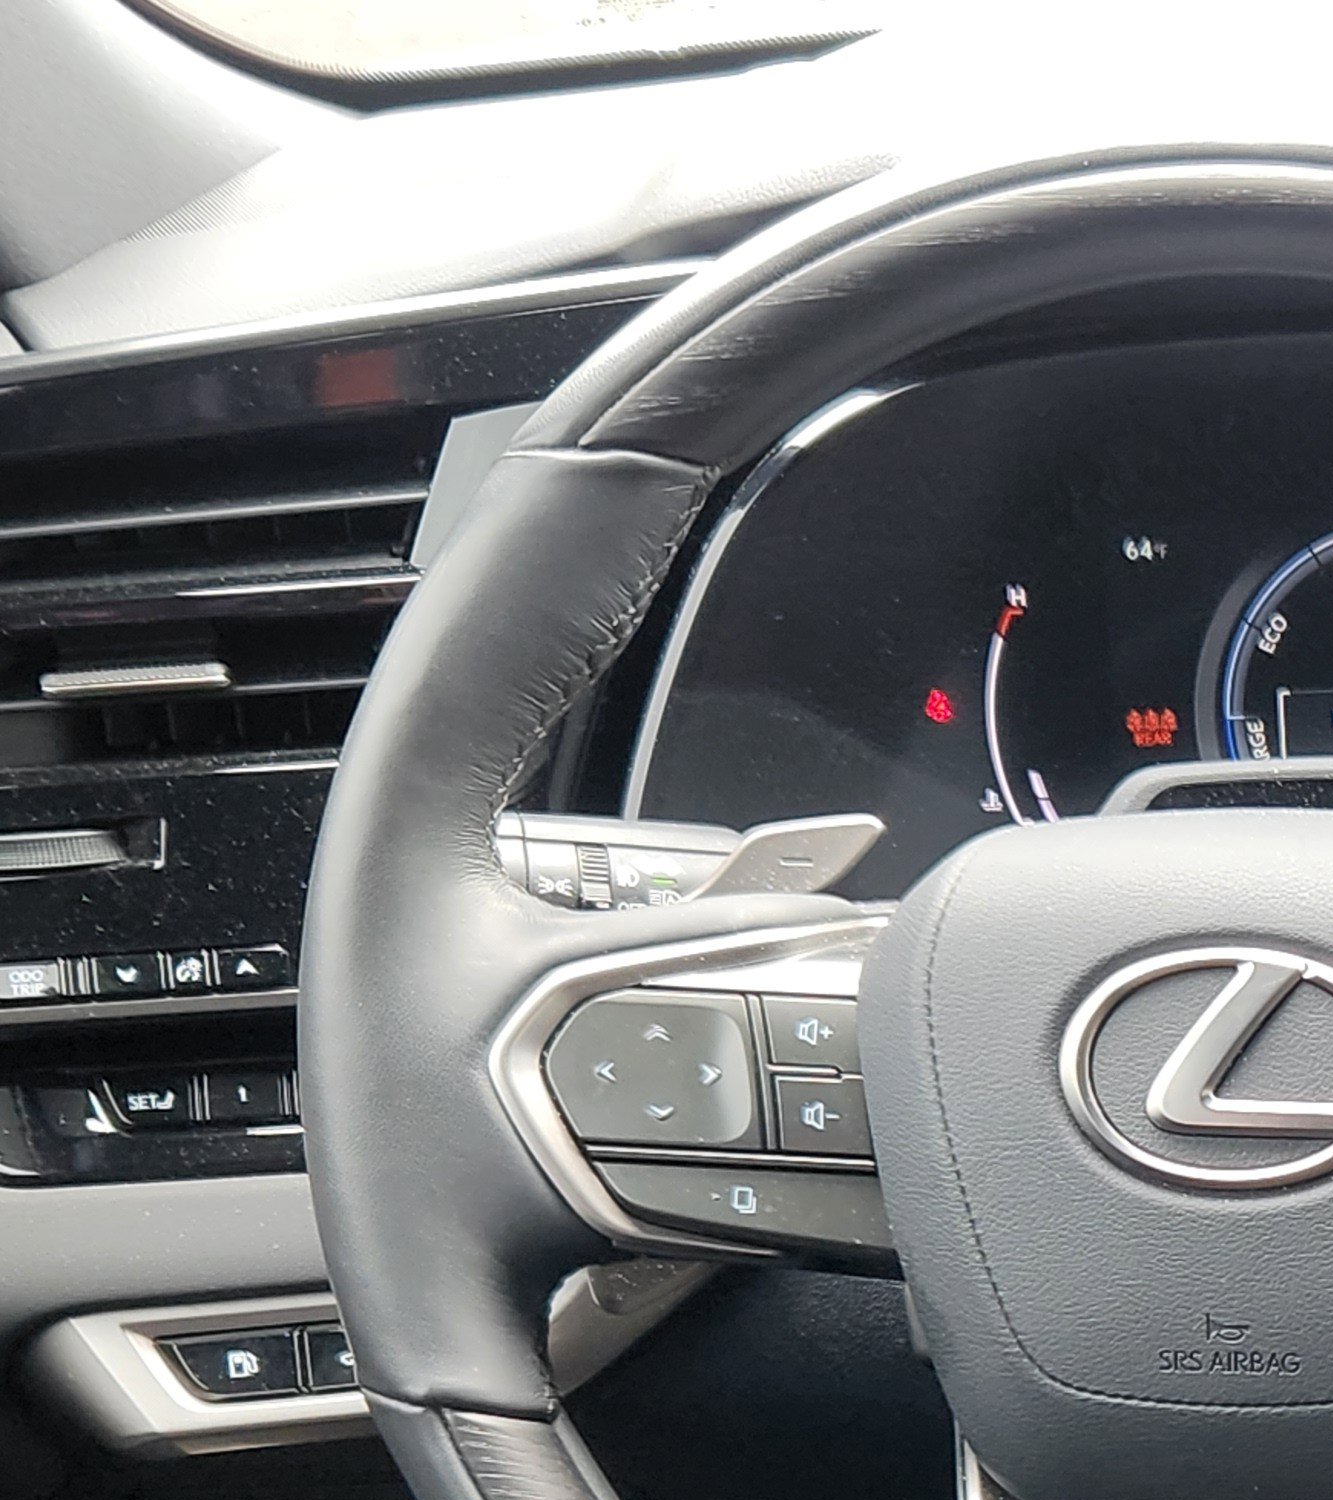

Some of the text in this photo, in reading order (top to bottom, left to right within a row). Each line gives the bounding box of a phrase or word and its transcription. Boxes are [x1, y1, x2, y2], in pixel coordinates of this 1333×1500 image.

[1006, 583, 1028, 608] H
[1257, 612, 1288, 655] ECO
[1246, 719, 1270, 761] RGE
[9, 968, 43, 983] ODO
[10, 982, 45, 996] TRIP
[127, 1092, 159, 1111] SET
[1158, 1349, 1302, 1376] SRS AIRBAG
